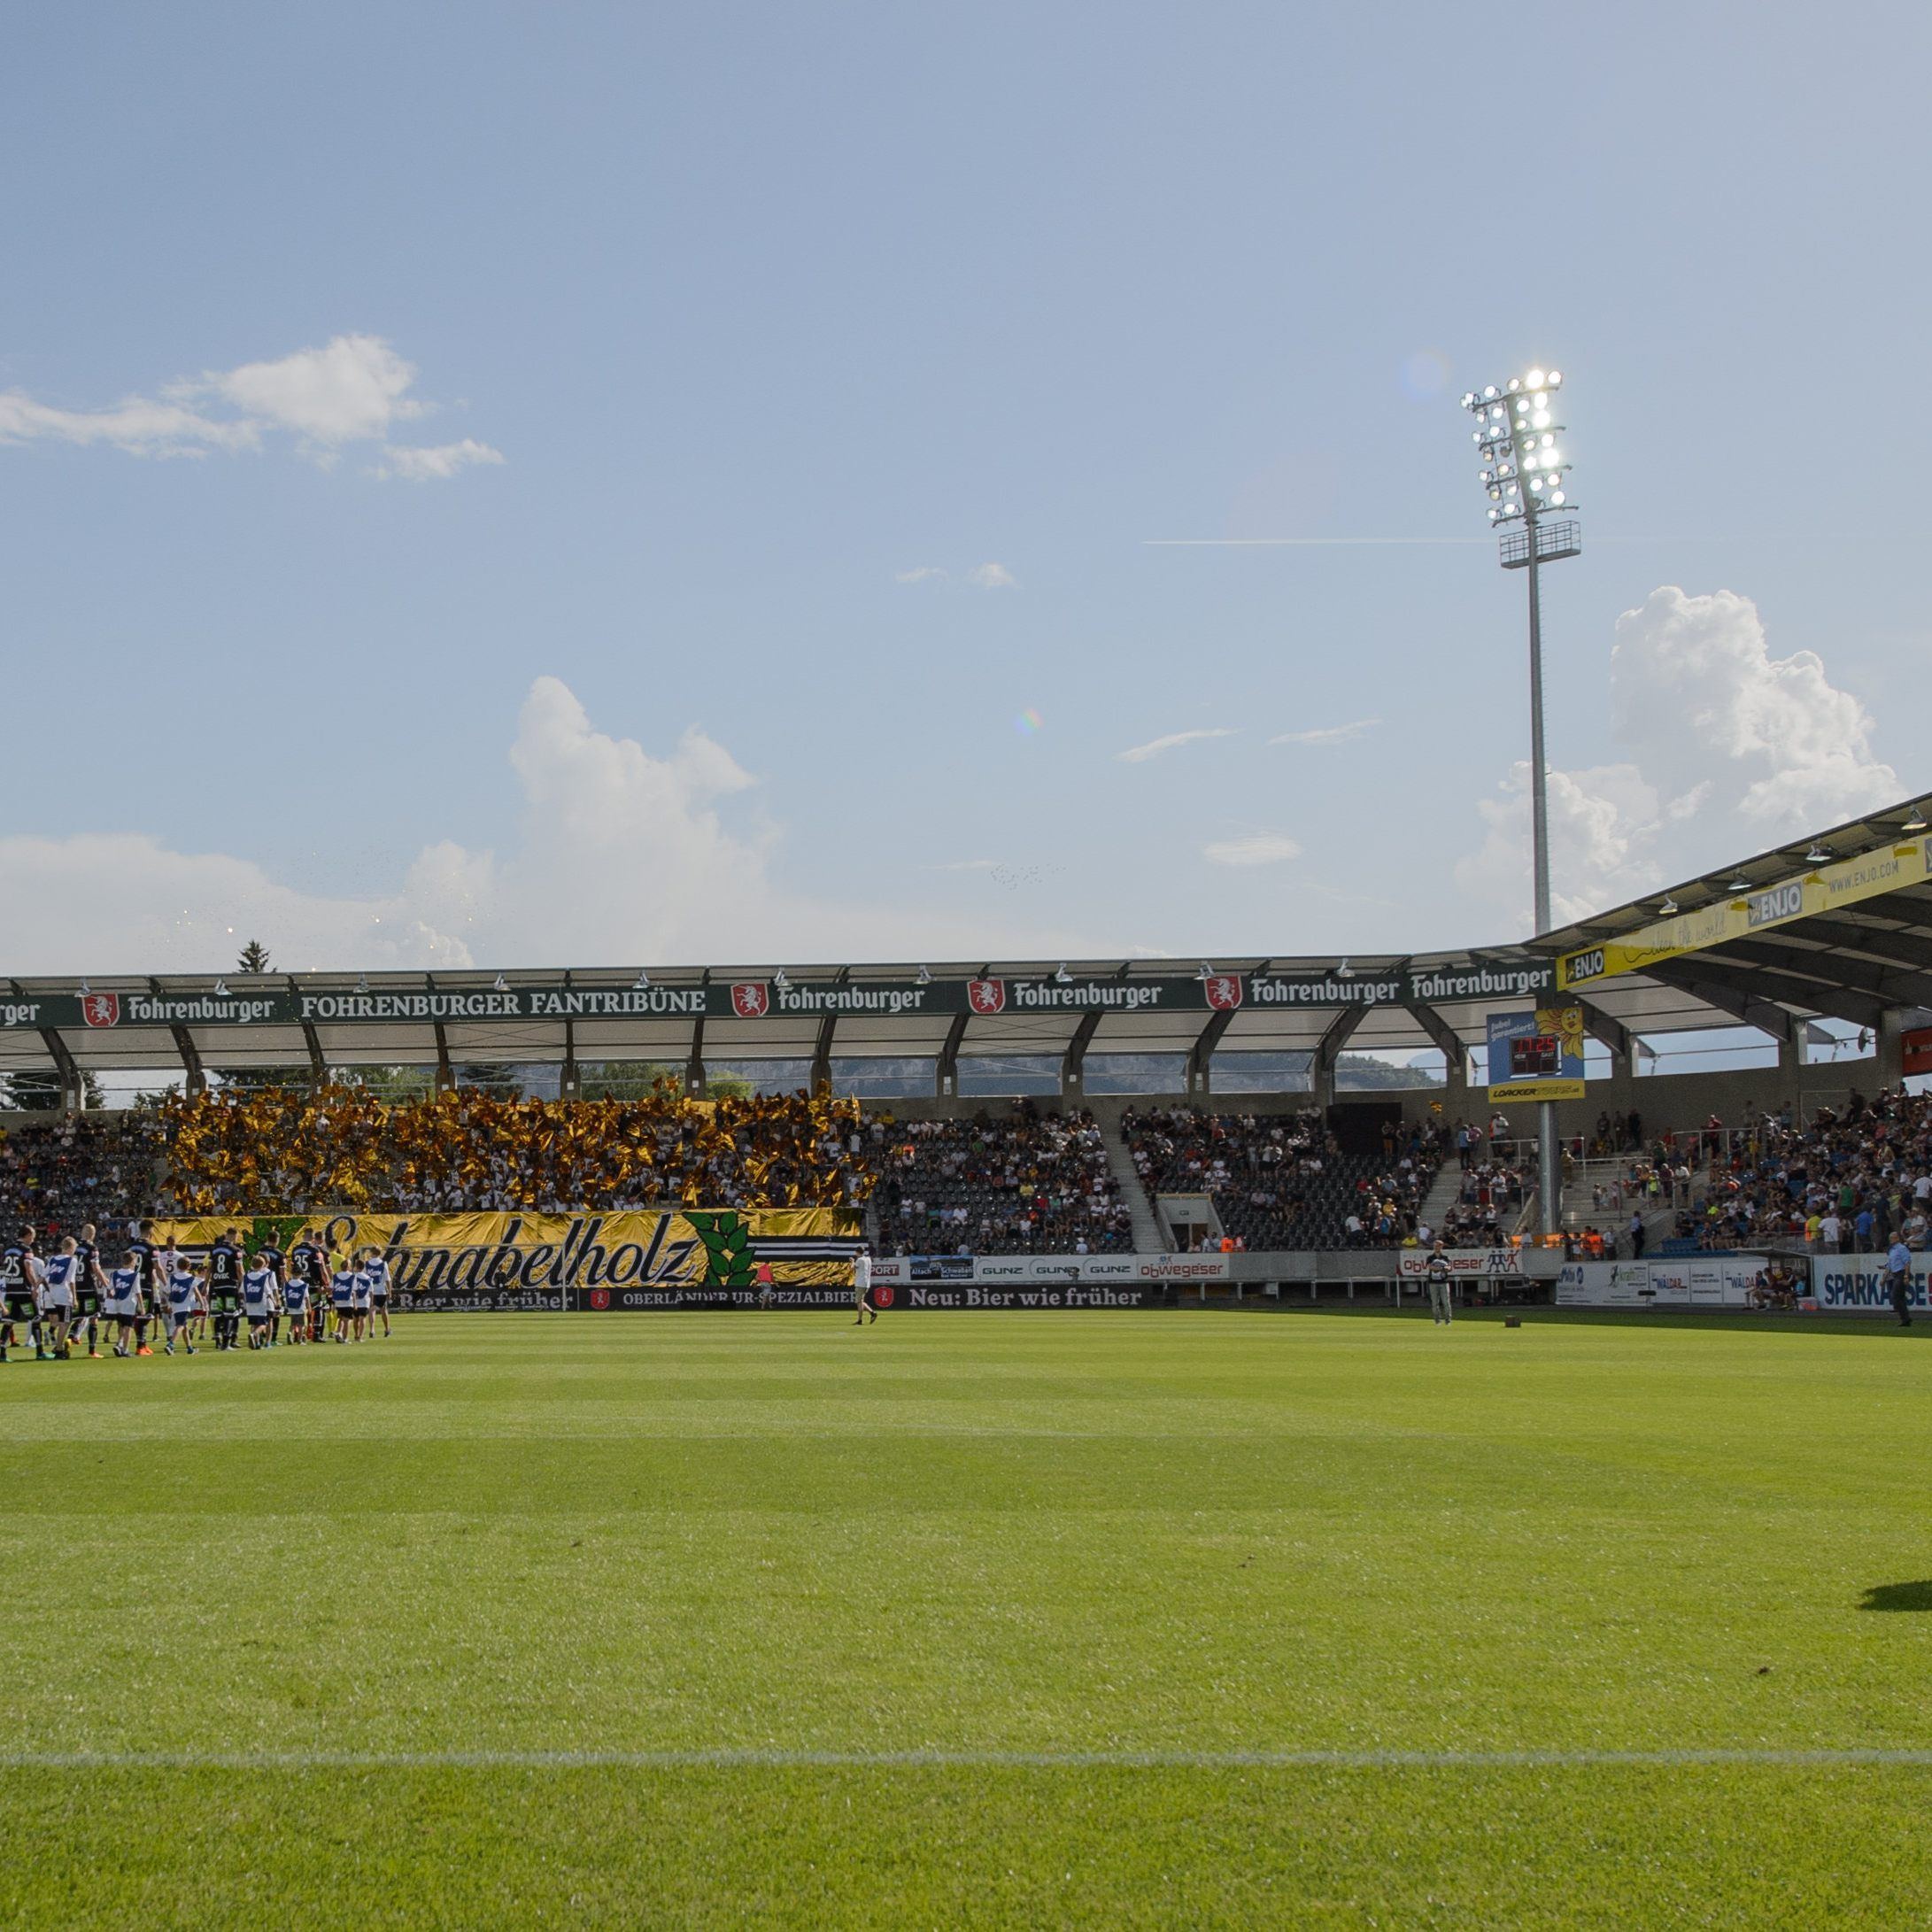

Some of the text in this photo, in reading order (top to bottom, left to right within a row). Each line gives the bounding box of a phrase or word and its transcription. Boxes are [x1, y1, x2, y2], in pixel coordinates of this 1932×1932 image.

[1828, 860, 1899, 893] WWW.ENJO.COM
[1760, 885, 1801, 920] ENJO
[1573, 951, 1604, 979] ENJO
[1014, 982, 1163, 1009] Fohrenburger
[1251, 978, 1399, 1004] Fohrenburger
[1411, 969, 1552, 998] Fohrenburger
[128, 996, 275, 1023] Fohrenburger
[301, 986, 706, 1017] FOHRENBURGER FANTRIBÜNE
[777, 986, 925, 1012] Fohrenburger
[4, 1256, 20, 1277] 25
[166, 1260, 174, 1272] 5
[217, 1255, 225, 1272] 8
[1140, 1264, 1223, 1278] obwegeser
[909, 1287, 1142, 1306] Neu: Bier wie früher
[1825, 1273, 1927, 1306] SPARKASE
